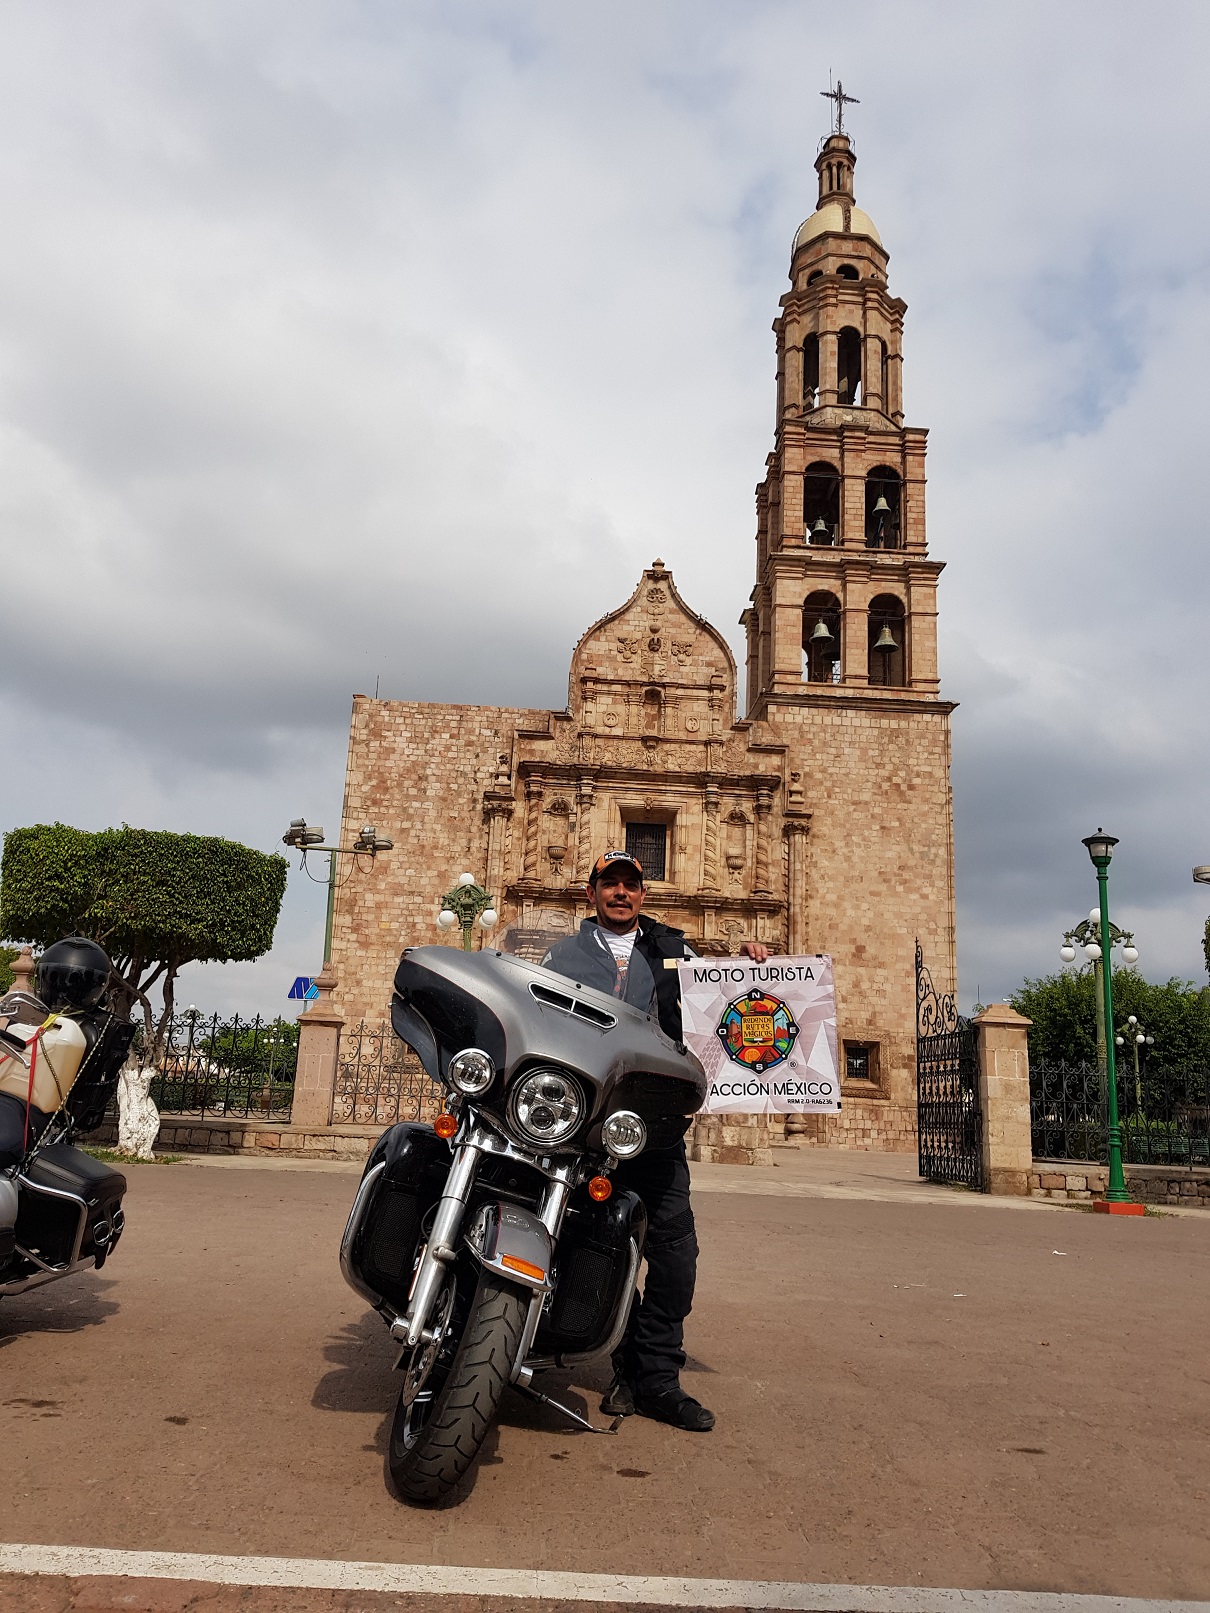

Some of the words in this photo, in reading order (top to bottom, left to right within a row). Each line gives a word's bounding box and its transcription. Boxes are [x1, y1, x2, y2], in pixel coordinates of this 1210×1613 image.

[693, 968, 745, 983] MOTO
[749, 967, 815, 982] TURISTA
[755, 1063, 764, 1071] S
[709, 1079, 770, 1097] ACCIÓN
[773, 1078, 833, 1096] MÉXICO
